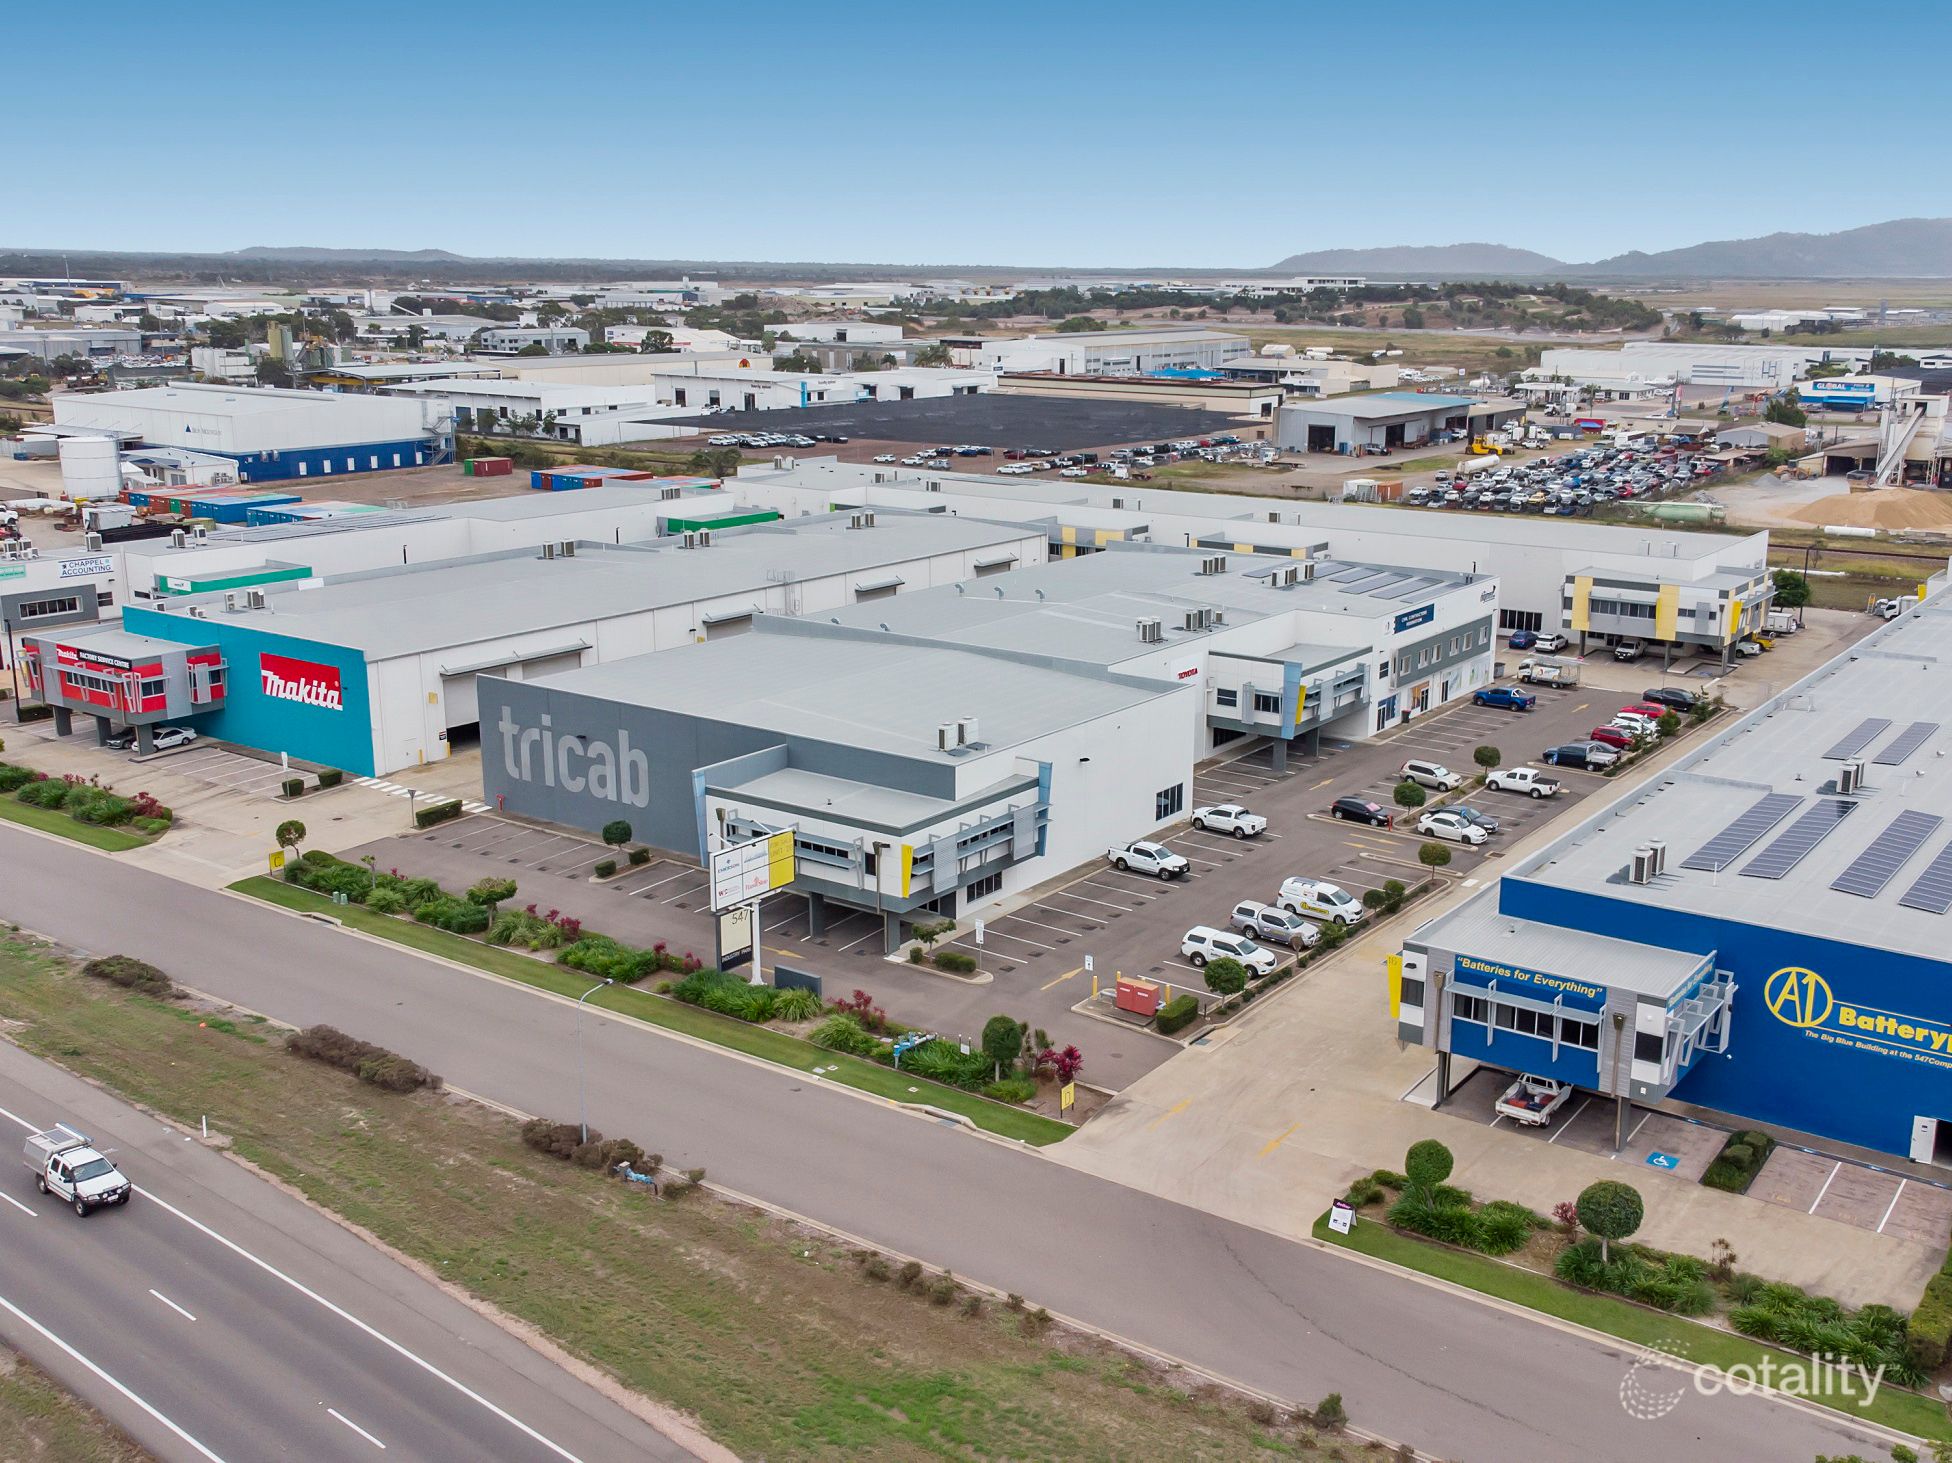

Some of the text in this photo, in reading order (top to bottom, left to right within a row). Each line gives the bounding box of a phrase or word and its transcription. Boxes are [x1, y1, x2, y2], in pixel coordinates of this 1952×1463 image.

[1817, 382, 1846, 391] GLOBAL
[62, 565, 111, 576] ACCOUNTING
[68, 559, 103, 569] CHAPPEL
[499, 706, 649, 808] tricab
[732, 910, 748, 924] 547
[1514, 969, 1531, 981] for
[1769, 969, 1819, 1027] A1
[1839, 1006, 1952, 1054] Battery
[1805, 1030, 1819, 1039] The
[1821, 1033, 1834, 1043] Big
[1835, 1036, 1854, 1047] Blue
[1855, 1041, 1888, 1055] Building
[1899, 1050, 1913, 1060] the
